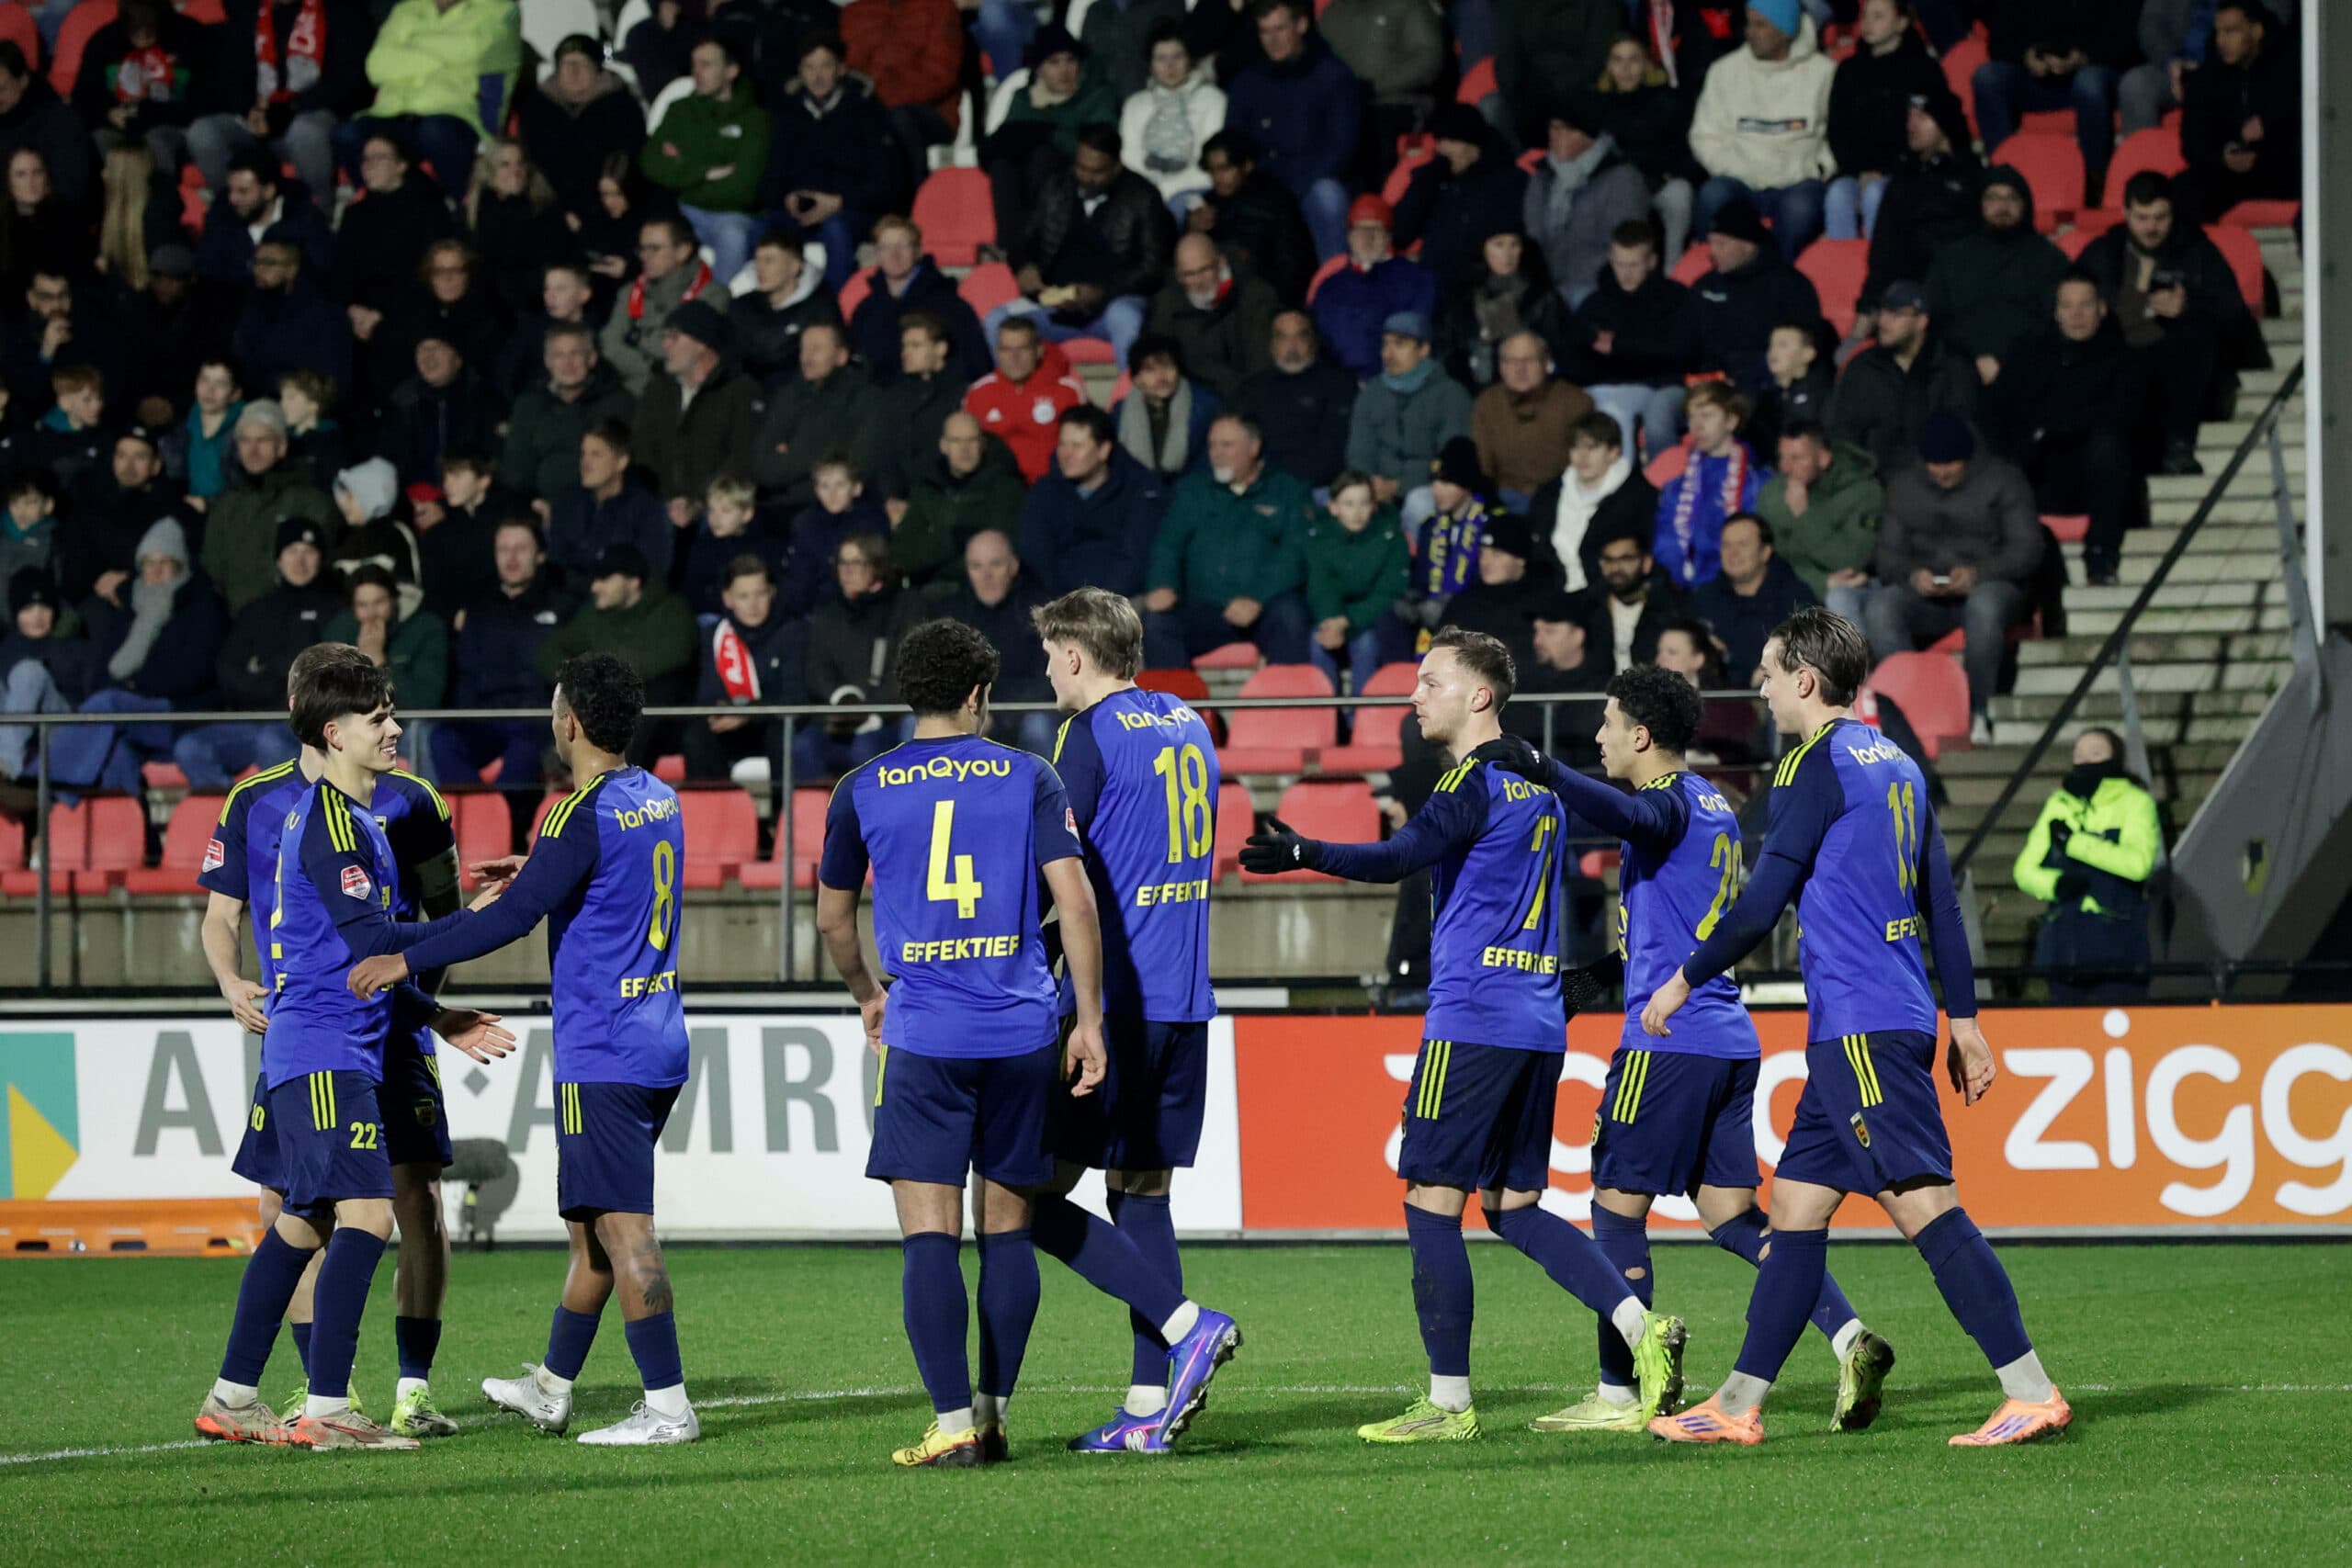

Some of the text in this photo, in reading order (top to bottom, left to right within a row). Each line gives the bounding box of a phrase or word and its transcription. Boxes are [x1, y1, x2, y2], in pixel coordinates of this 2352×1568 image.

[877, 756, 1011, 788] tanQyou
[1153, 743, 1213, 863] 18
[648, 840, 675, 952] 8
[926, 800, 984, 919] 4
[1521, 815, 1558, 931] 7
[1887, 781, 1918, 897] 11
[901, 934, 1020, 963] EFFEKTIEF
[349, 1121, 379, 1150] 22
